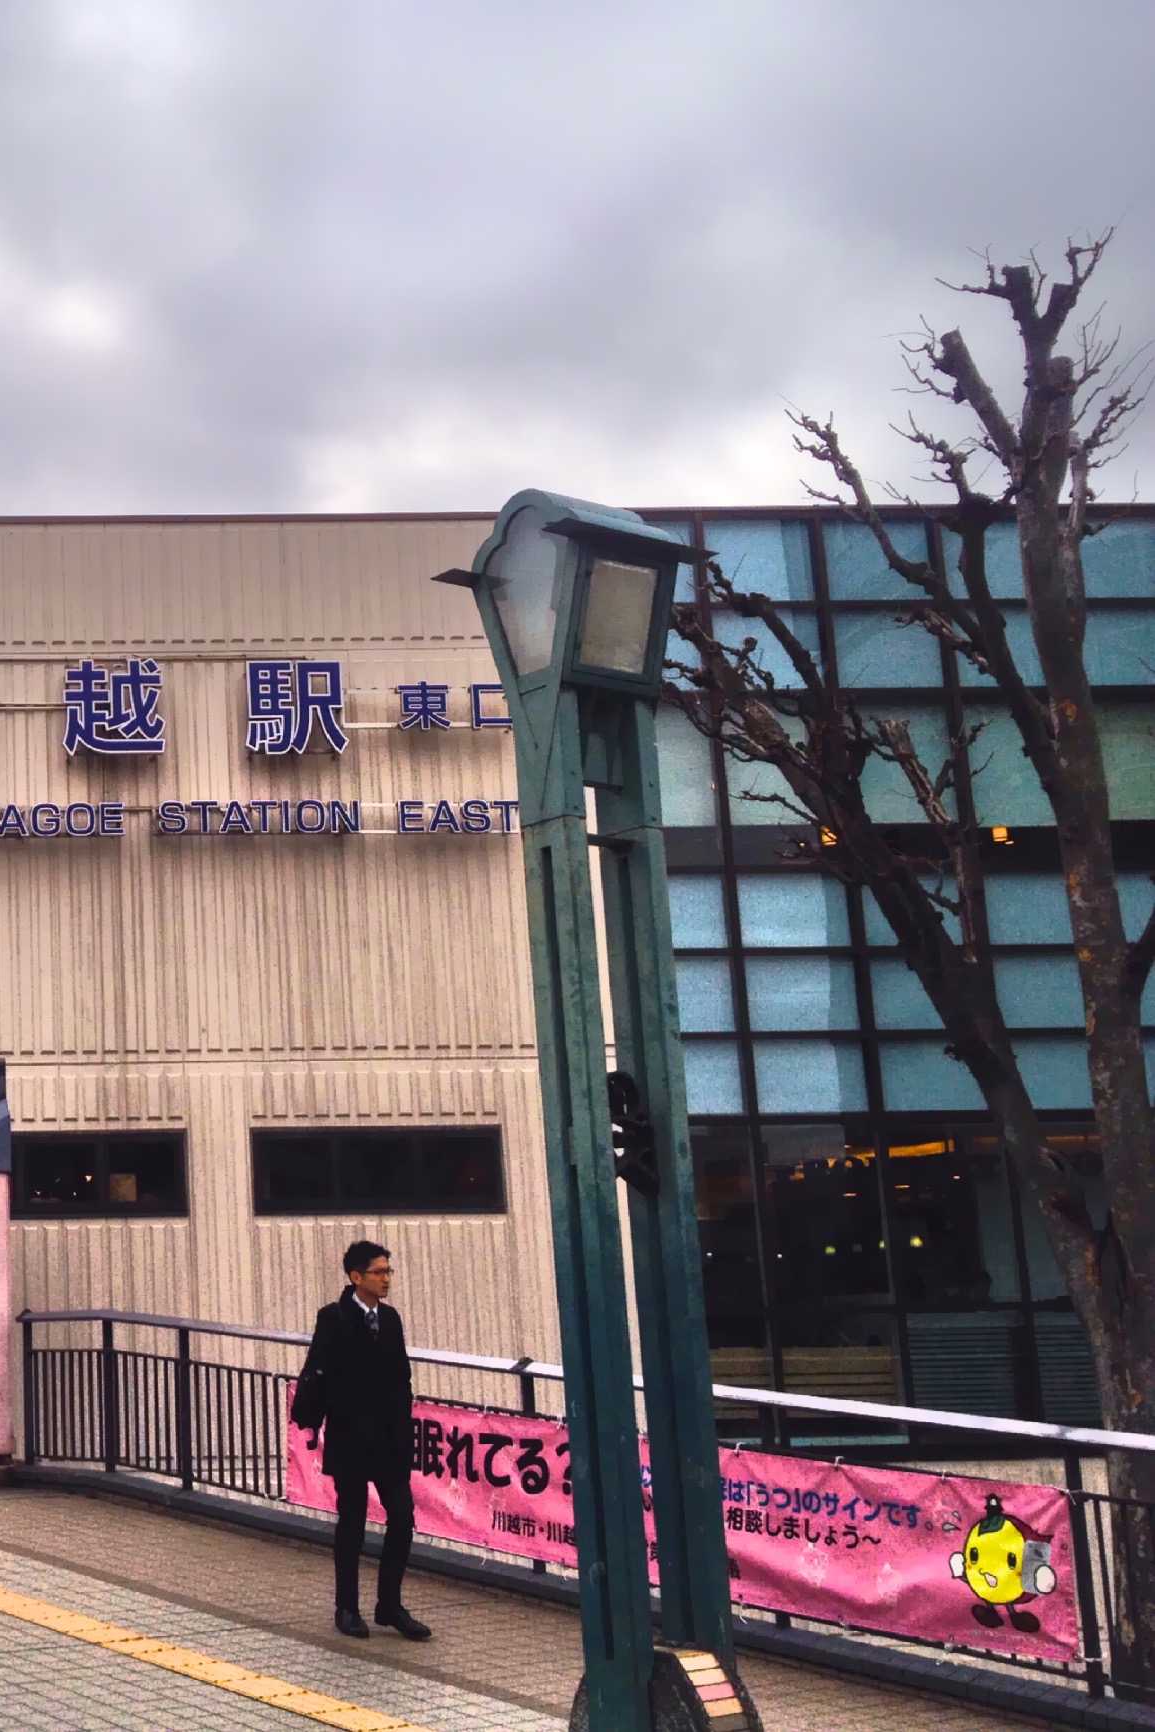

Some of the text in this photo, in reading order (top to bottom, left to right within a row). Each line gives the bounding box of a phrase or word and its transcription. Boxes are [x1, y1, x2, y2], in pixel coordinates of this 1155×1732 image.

[397, 681, 513, 731] 東口
[158, 800, 361, 835] STATION
[398, 799, 519, 834] EAST
